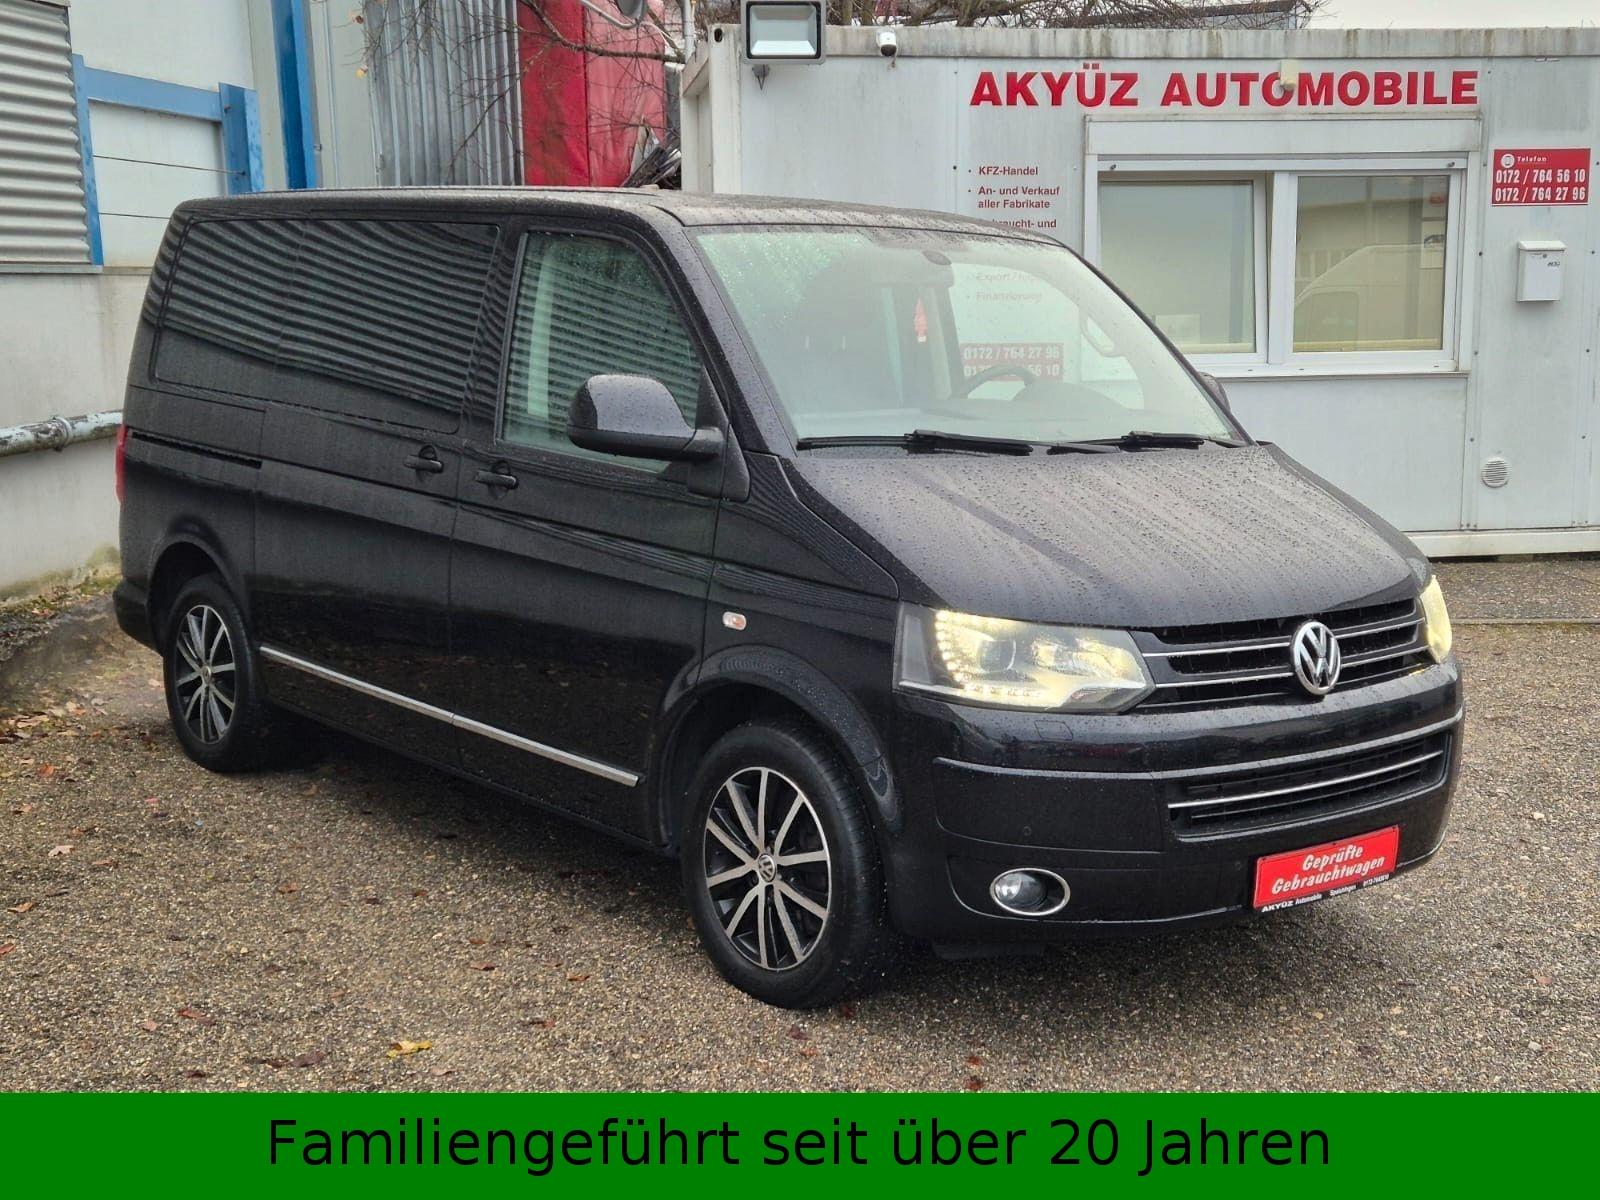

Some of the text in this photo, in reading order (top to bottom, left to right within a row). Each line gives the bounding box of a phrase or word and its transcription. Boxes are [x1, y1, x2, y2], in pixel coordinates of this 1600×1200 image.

[970, 63, 1478, 107] AKYÜZ AUTOMOBILE
[978, 166, 1038, 176] KFZ-Handel
[1496, 169, 1586, 185] 0172 / 764 56 10
[978, 186, 1060, 196] An- und Verkauf
[1495, 187, 1586, 203] 0172 / 764 27 96
[978, 199, 1050, 209] aller Fabrikate
[1037, 219, 1057, 228] und
[964, 347, 993, 360] 0172
[1028, 347, 1042, 359] 27
[1045, 364, 1060, 376] 10
[1303, 845, 1364, 872] Geprüfte
[1271, 856, 1385, 894] Gebrauchtwagen
